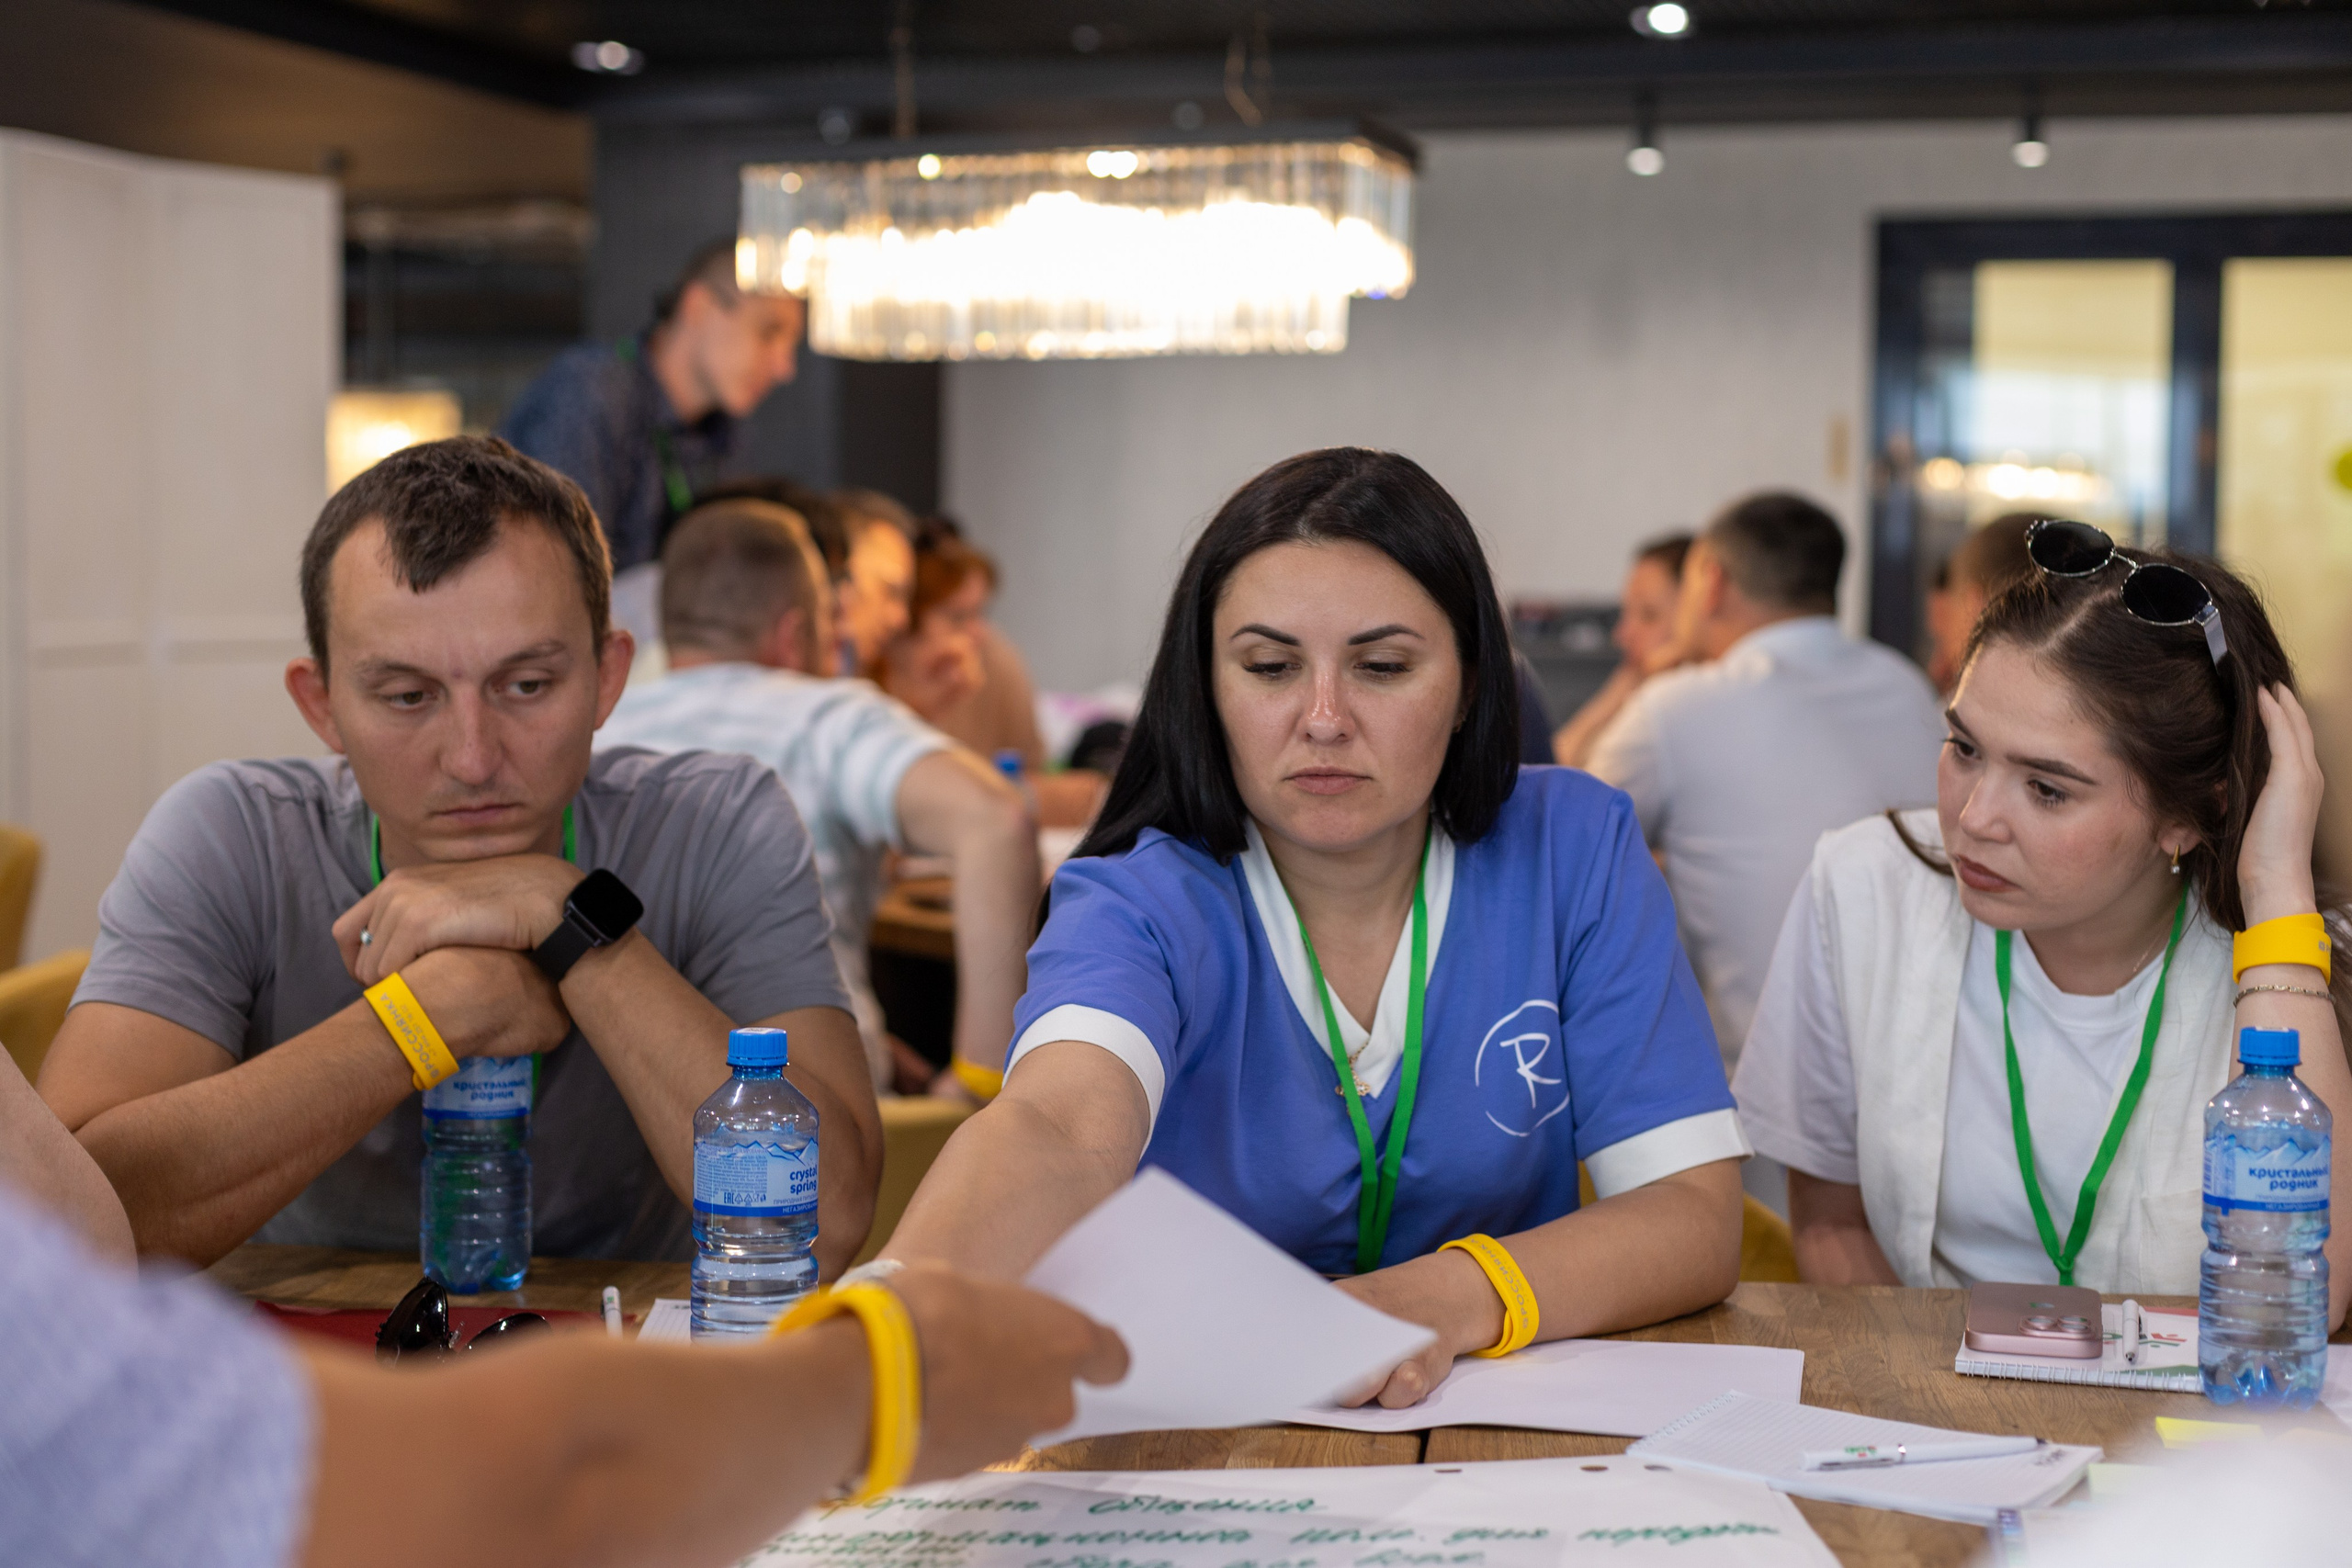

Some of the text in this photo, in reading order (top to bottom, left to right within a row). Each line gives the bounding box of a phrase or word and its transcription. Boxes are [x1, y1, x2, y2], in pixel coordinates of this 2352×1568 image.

[1499, 1032, 1562, 1109] R
[789, 1165, 818, 1182] crystal
[790, 1179, 817, 1195] spring
[2269, 1179, 2319, 1191] родник
